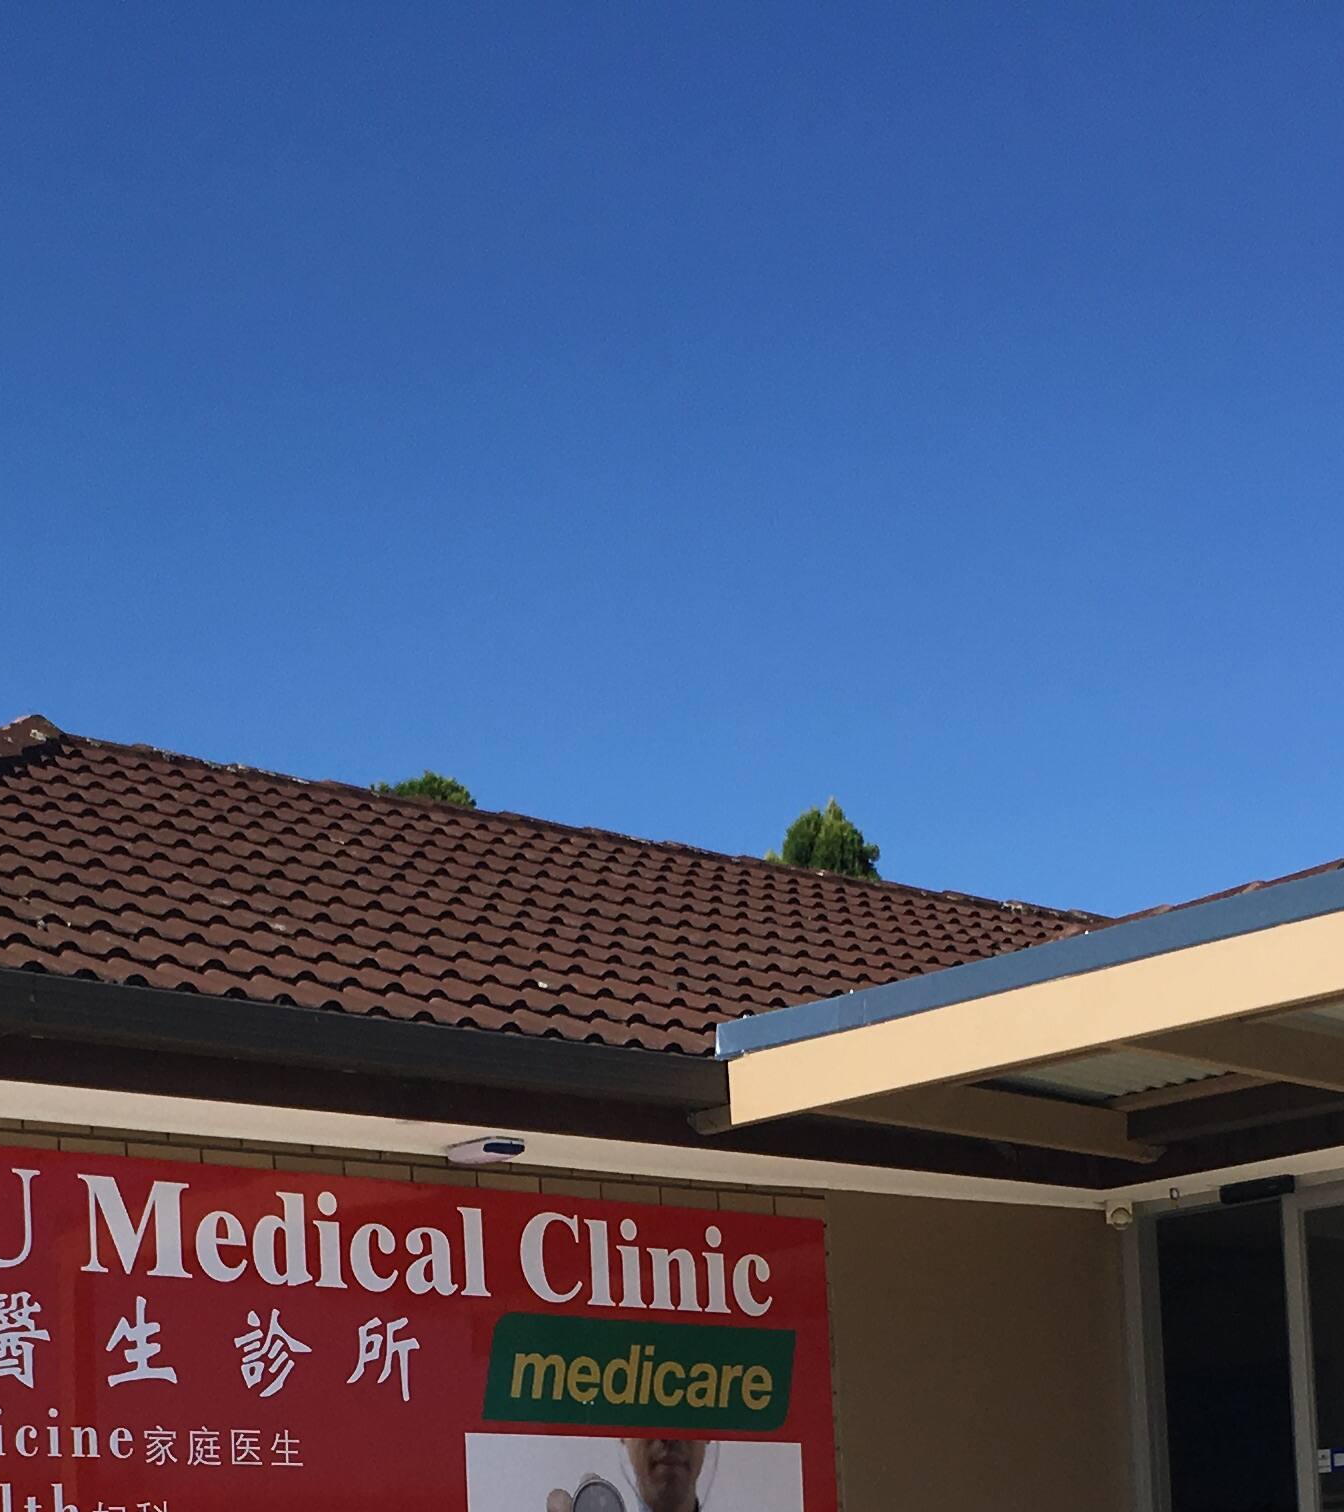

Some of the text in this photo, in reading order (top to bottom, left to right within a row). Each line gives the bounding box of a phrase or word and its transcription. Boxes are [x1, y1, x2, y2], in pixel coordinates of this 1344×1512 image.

[77, 1173, 492, 1298] Medical
[520, 1210, 774, 1317] Clinic
[509, 1344, 774, 1411] medicare
[142, 1424, 305, 1469] 家庭医生
